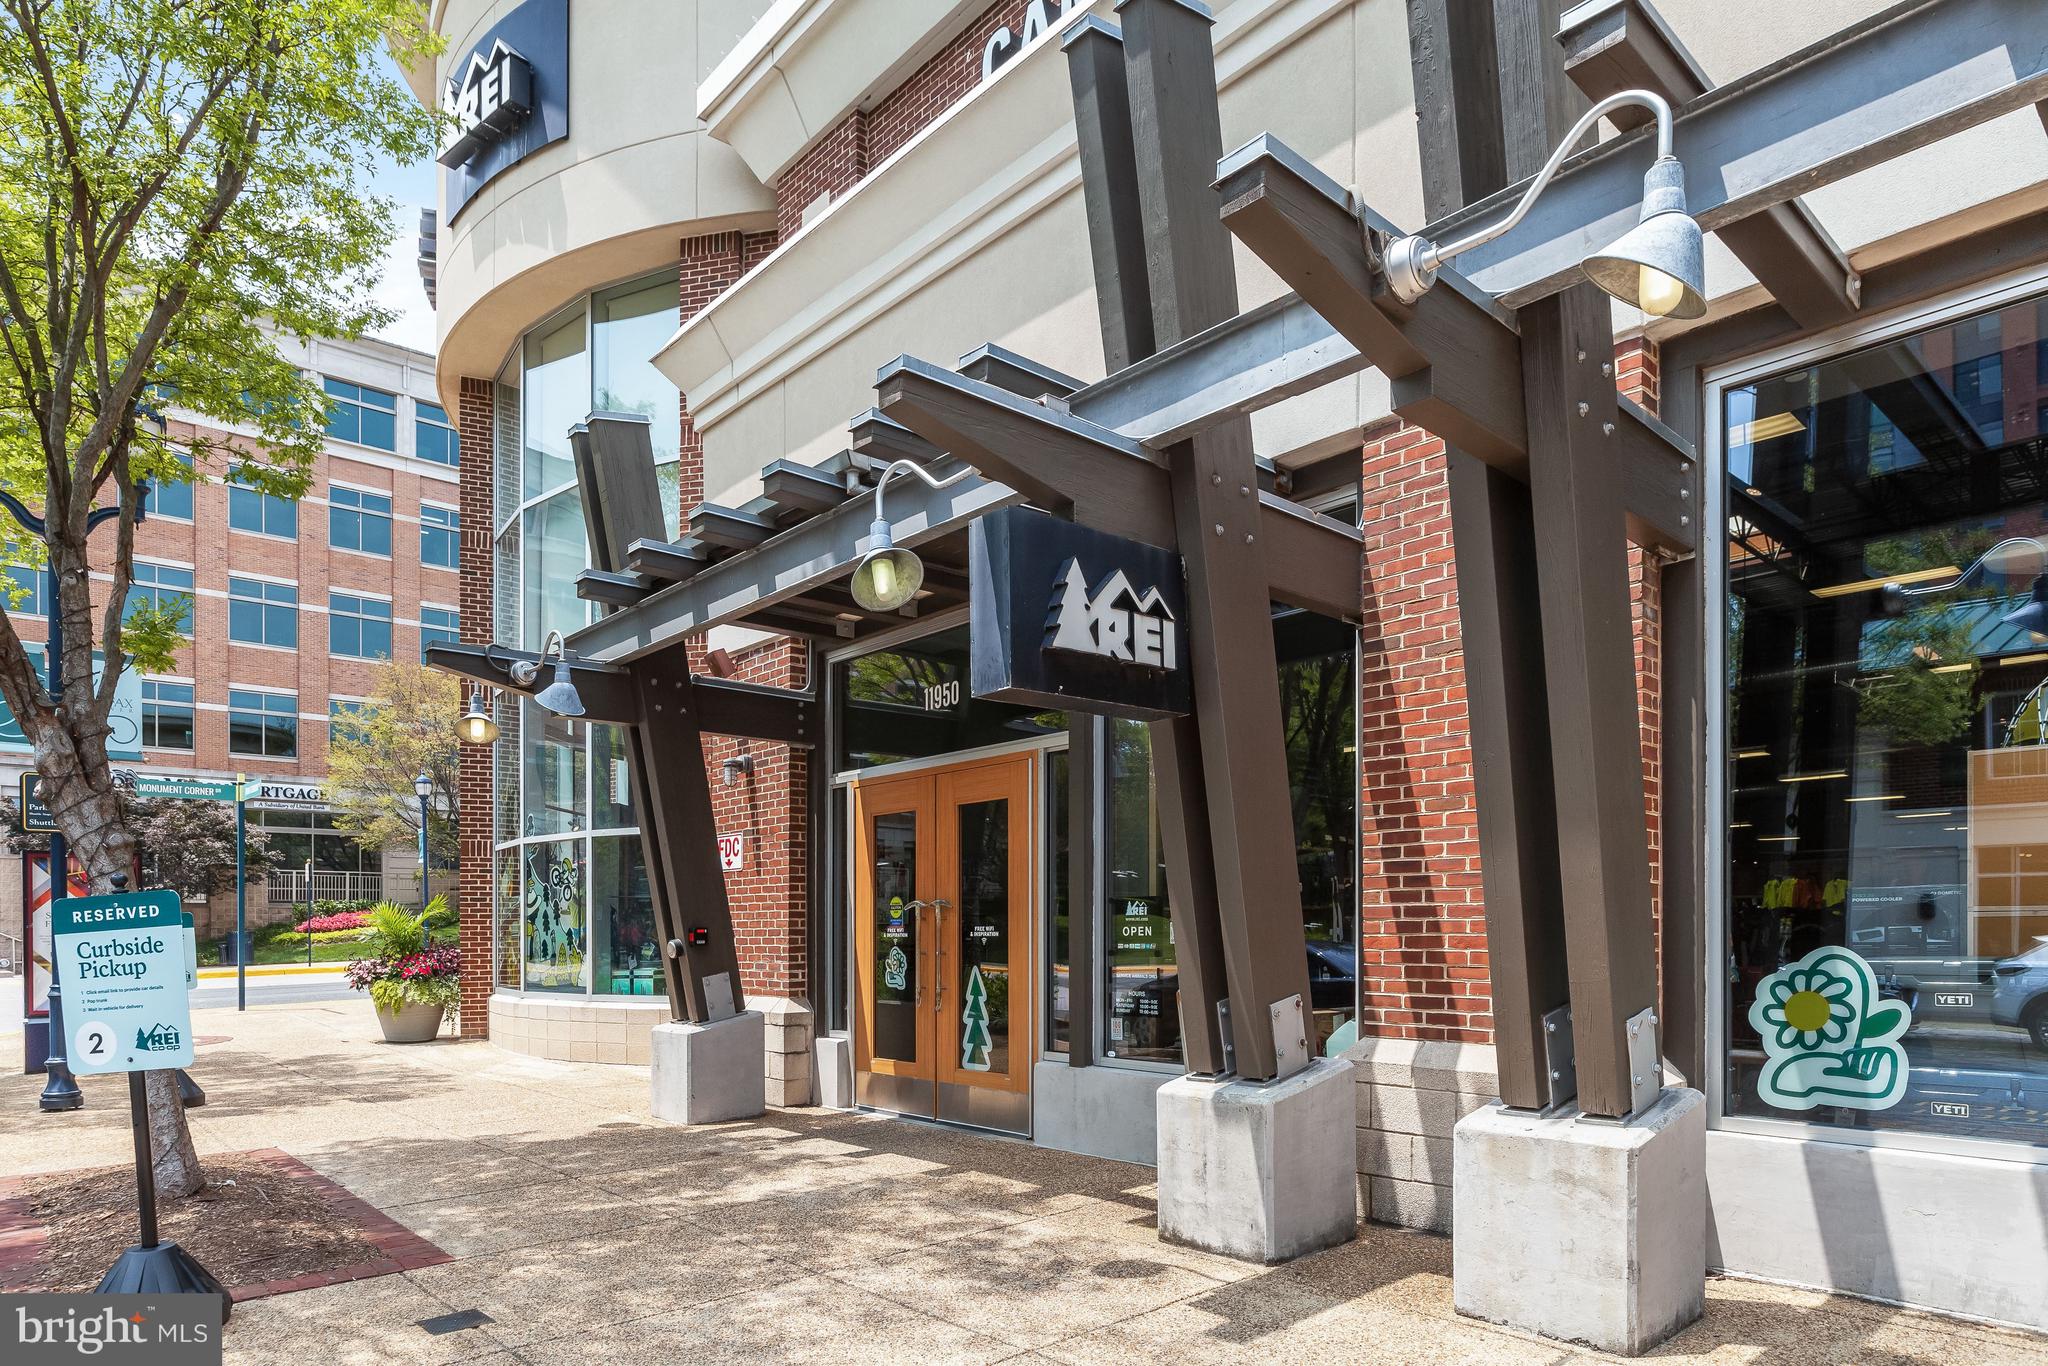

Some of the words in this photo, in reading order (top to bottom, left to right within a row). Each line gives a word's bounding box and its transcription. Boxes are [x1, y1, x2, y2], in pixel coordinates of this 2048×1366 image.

[924, 680, 960, 711] 11950
[139, 784, 183, 794] MONUMENT
[184, 786, 214, 796] CORNER
[265, 802, 289, 810] Subsidiary
[719, 837, 740, 858] FDC
[72, 904, 160, 924] RESERVED
[1122, 926, 1152, 936] OPEN
[76, 936, 165, 960] Curbside
[78, 960, 148, 980] Pickup
[1937, 995, 1969, 1005] YETI
[88, 1032, 104, 1054] 2
[1934, 1104, 1966, 1115] YETI
